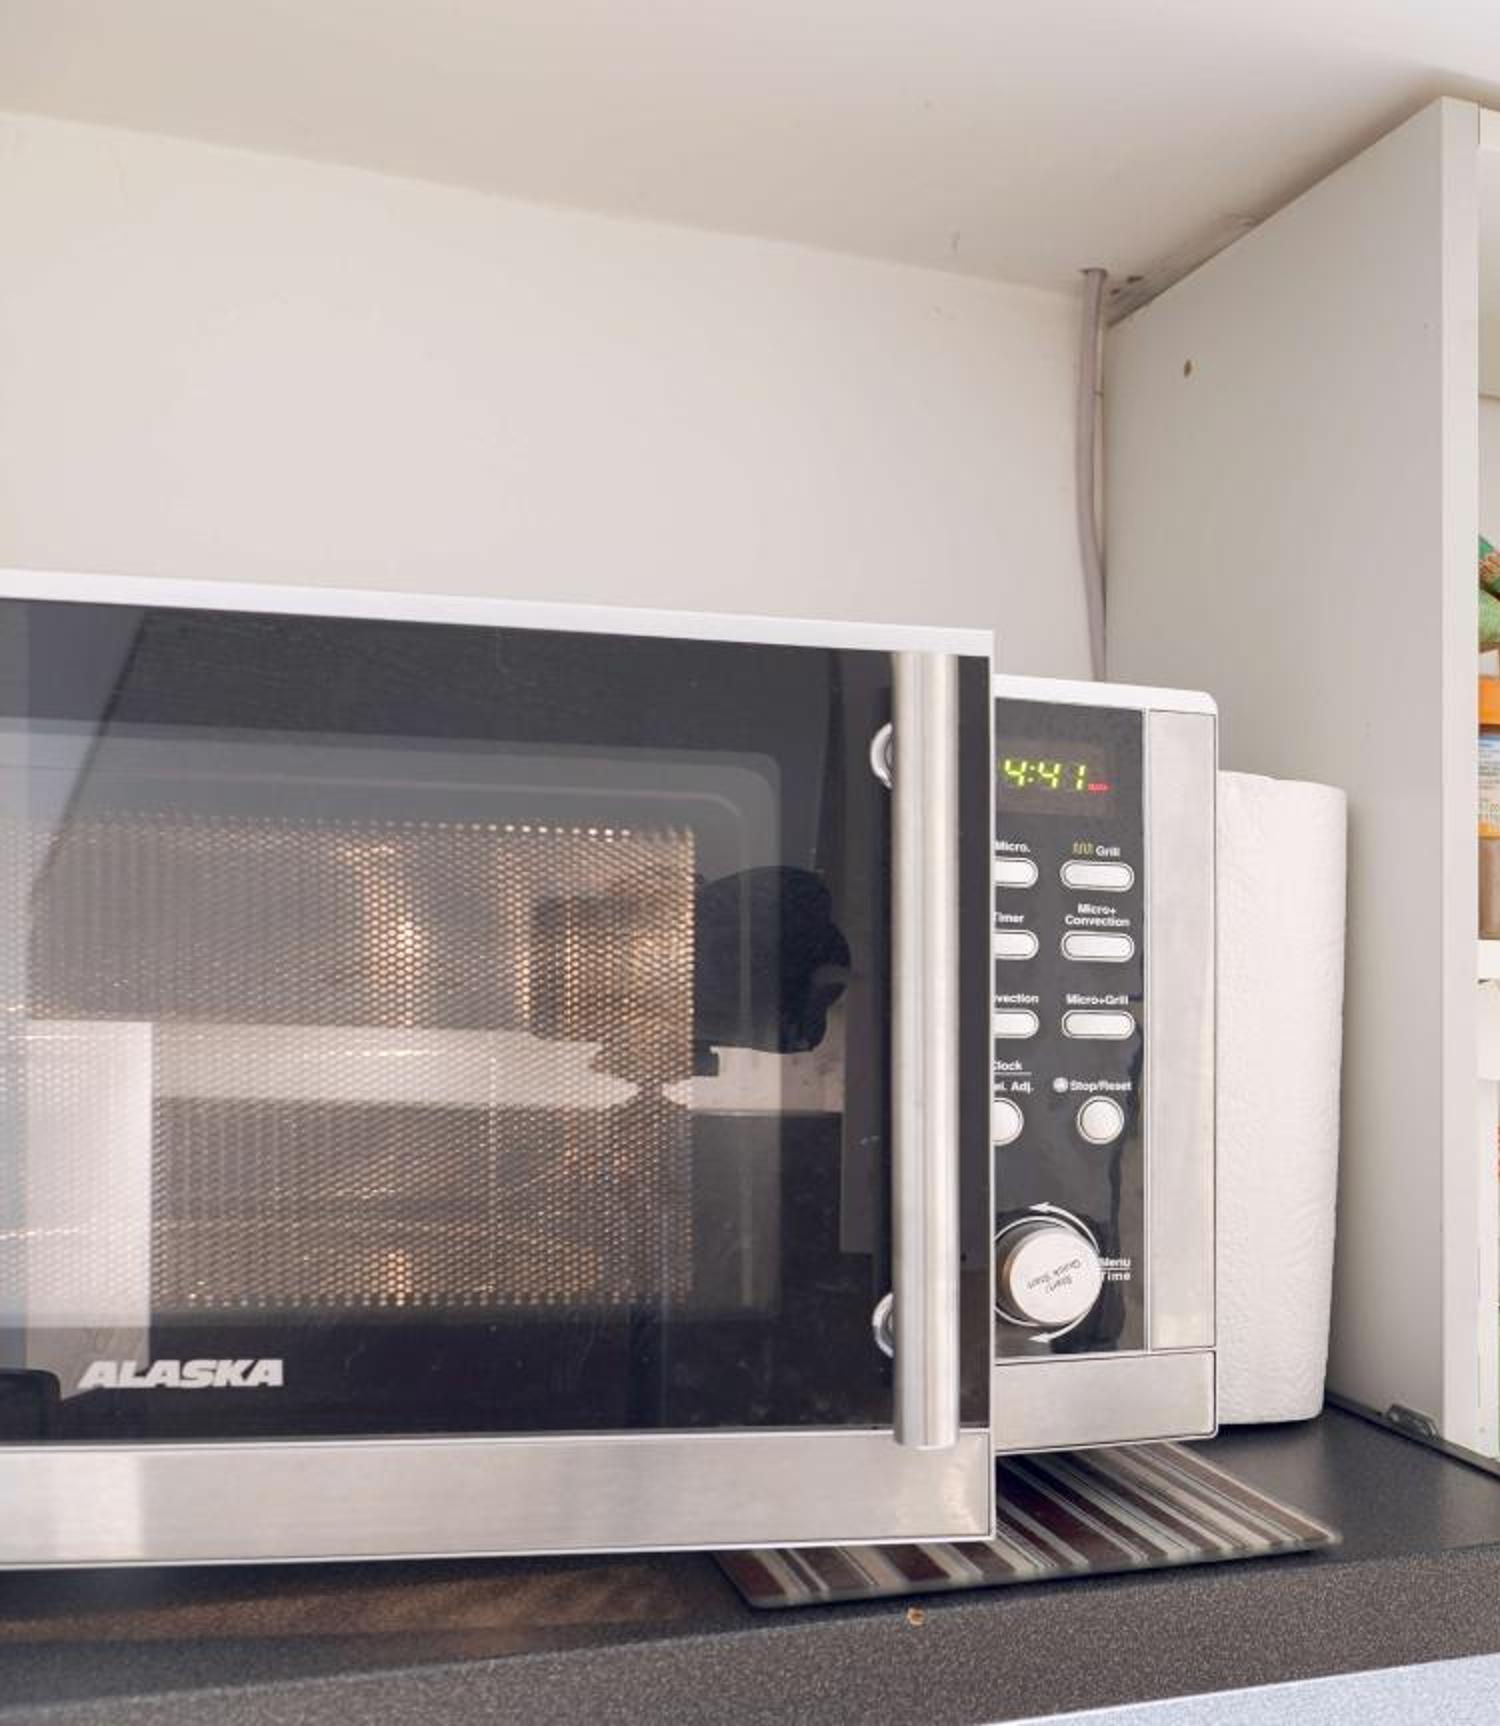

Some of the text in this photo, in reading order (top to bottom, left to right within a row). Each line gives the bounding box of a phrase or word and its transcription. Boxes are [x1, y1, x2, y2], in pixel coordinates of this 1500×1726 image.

[1004, 759, 1086, 790] 4:41
[1095, 844, 1121, 857] Grill
[1064, 915, 1131, 927] Convection
[1066, 993, 1129, 1006] Micro+Grill
[1070, 1080, 1133, 1093] Stop/Reset
[76, 1358, 284, 1389] ALASKA
